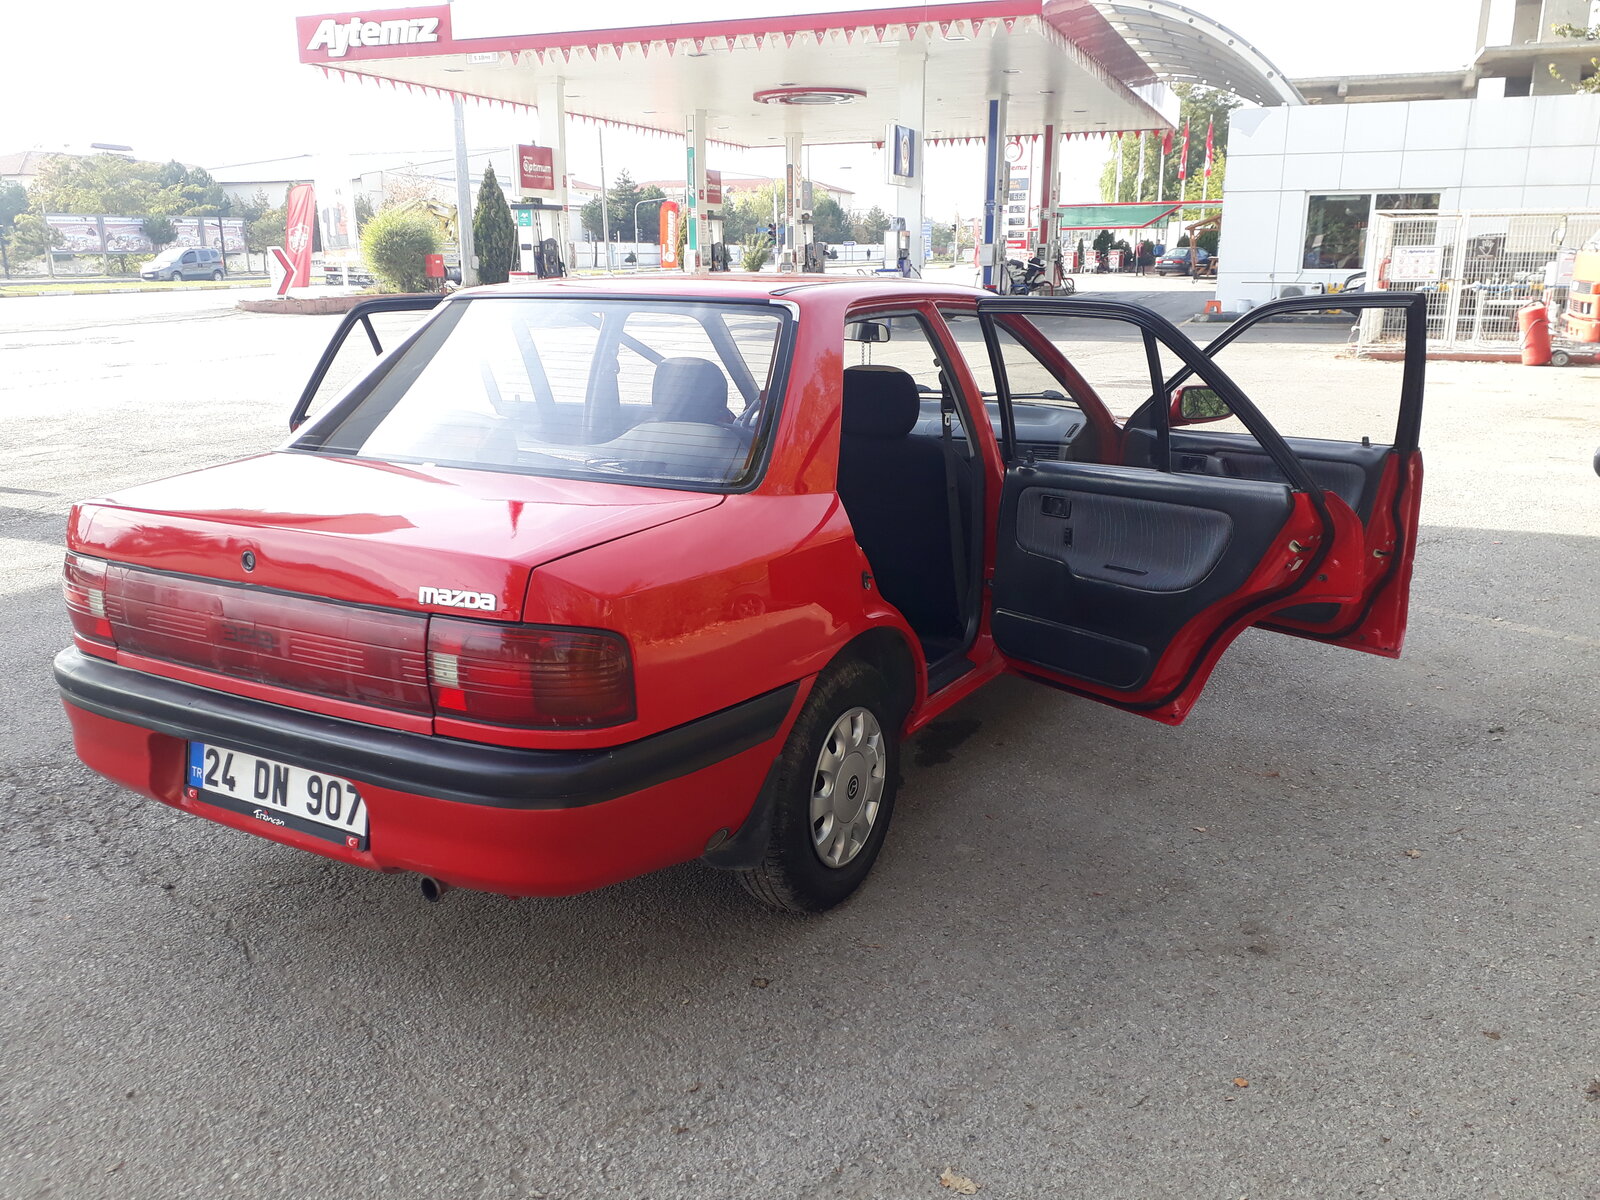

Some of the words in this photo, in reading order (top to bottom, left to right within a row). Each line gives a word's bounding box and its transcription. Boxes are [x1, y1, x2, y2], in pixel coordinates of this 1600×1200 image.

[306, 17, 439, 57] Aytemiz
[191, 766, 203, 778] TR
[205, 748, 236, 791] 24
[254, 760, 289, 807] DN
[306, 775, 362, 826] 907
